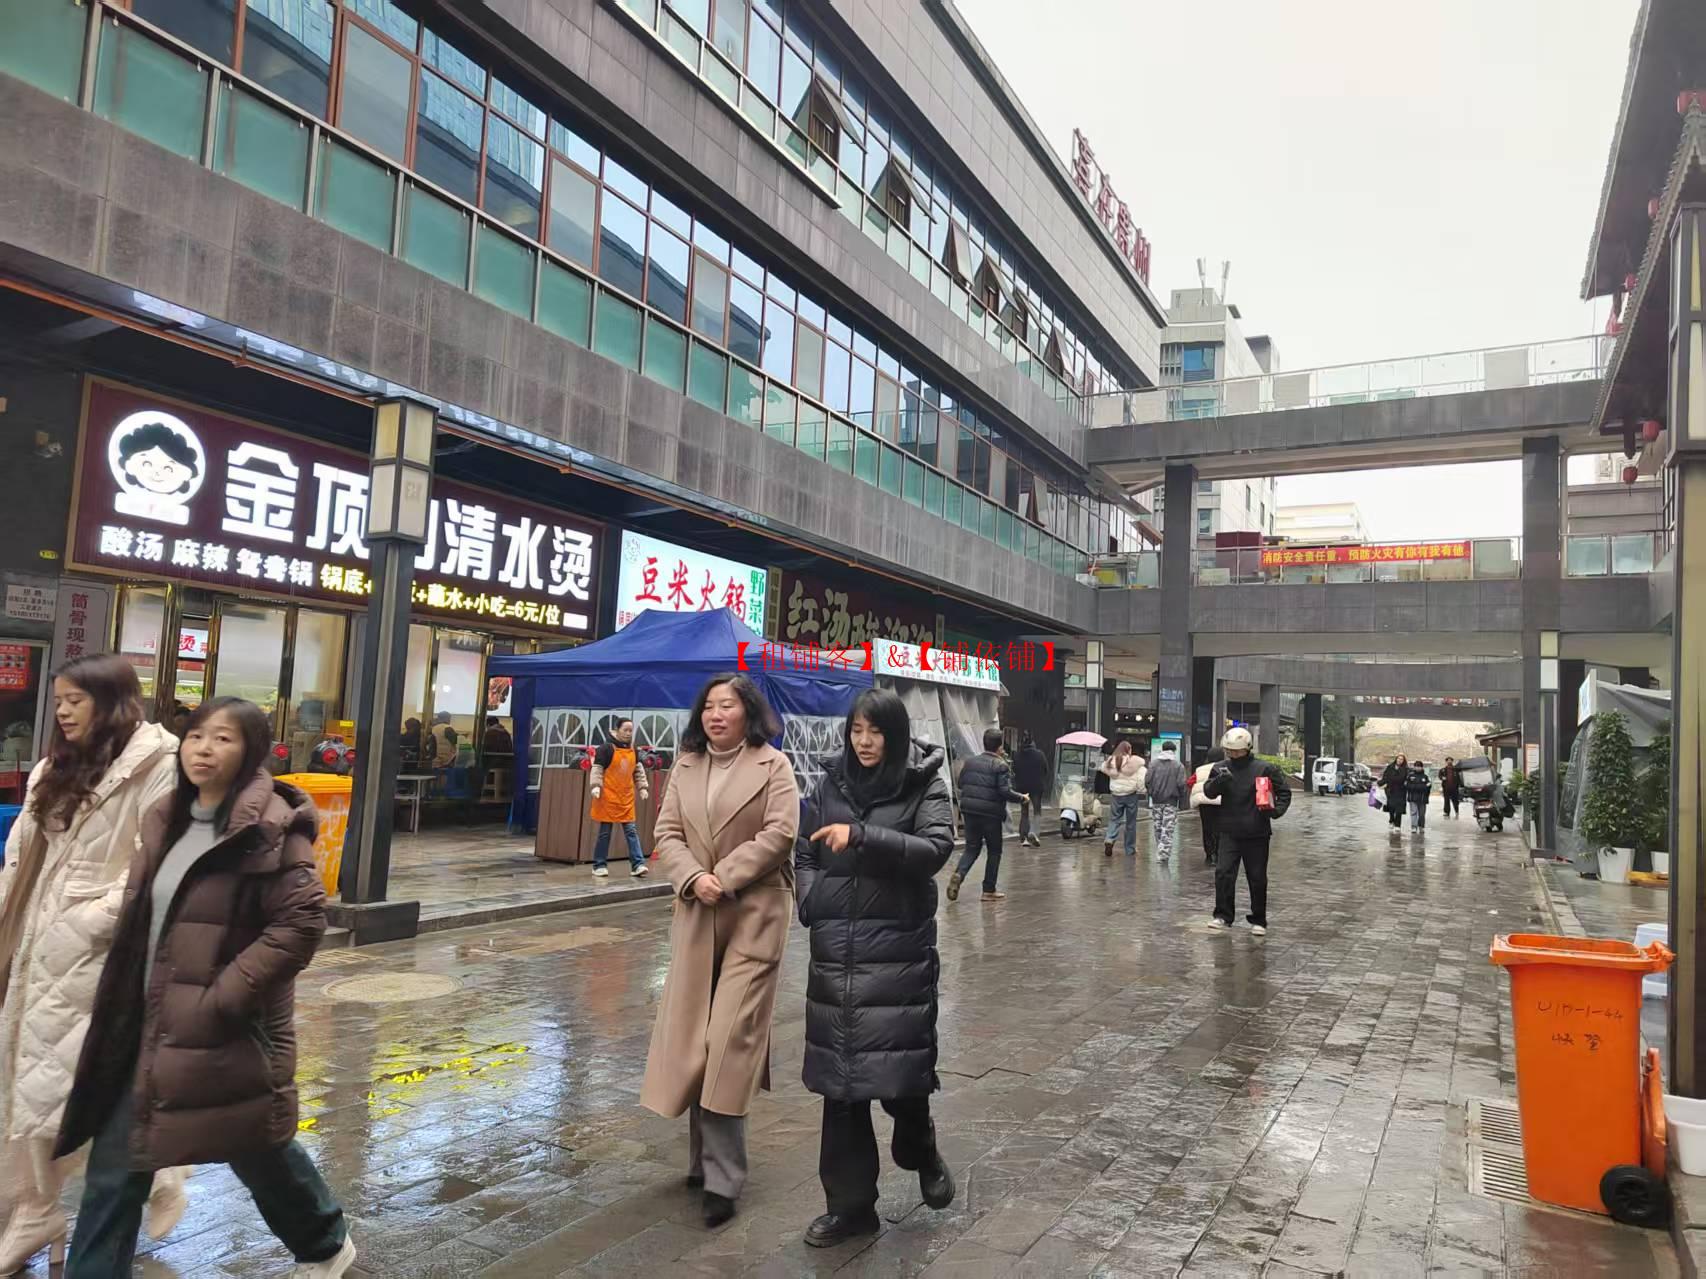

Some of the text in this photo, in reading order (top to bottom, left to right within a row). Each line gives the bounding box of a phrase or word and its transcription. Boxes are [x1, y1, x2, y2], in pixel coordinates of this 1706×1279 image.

[222, 441, 593, 601] 金顶清水烫
[100, 525, 561, 627] 酸汤 麻辣 鸳鸯锅 锅底++蘸水+小吃=6元/位
[635, 556, 747, 624] 豆米火锅
[749, 569, 765, 636] 野菜
